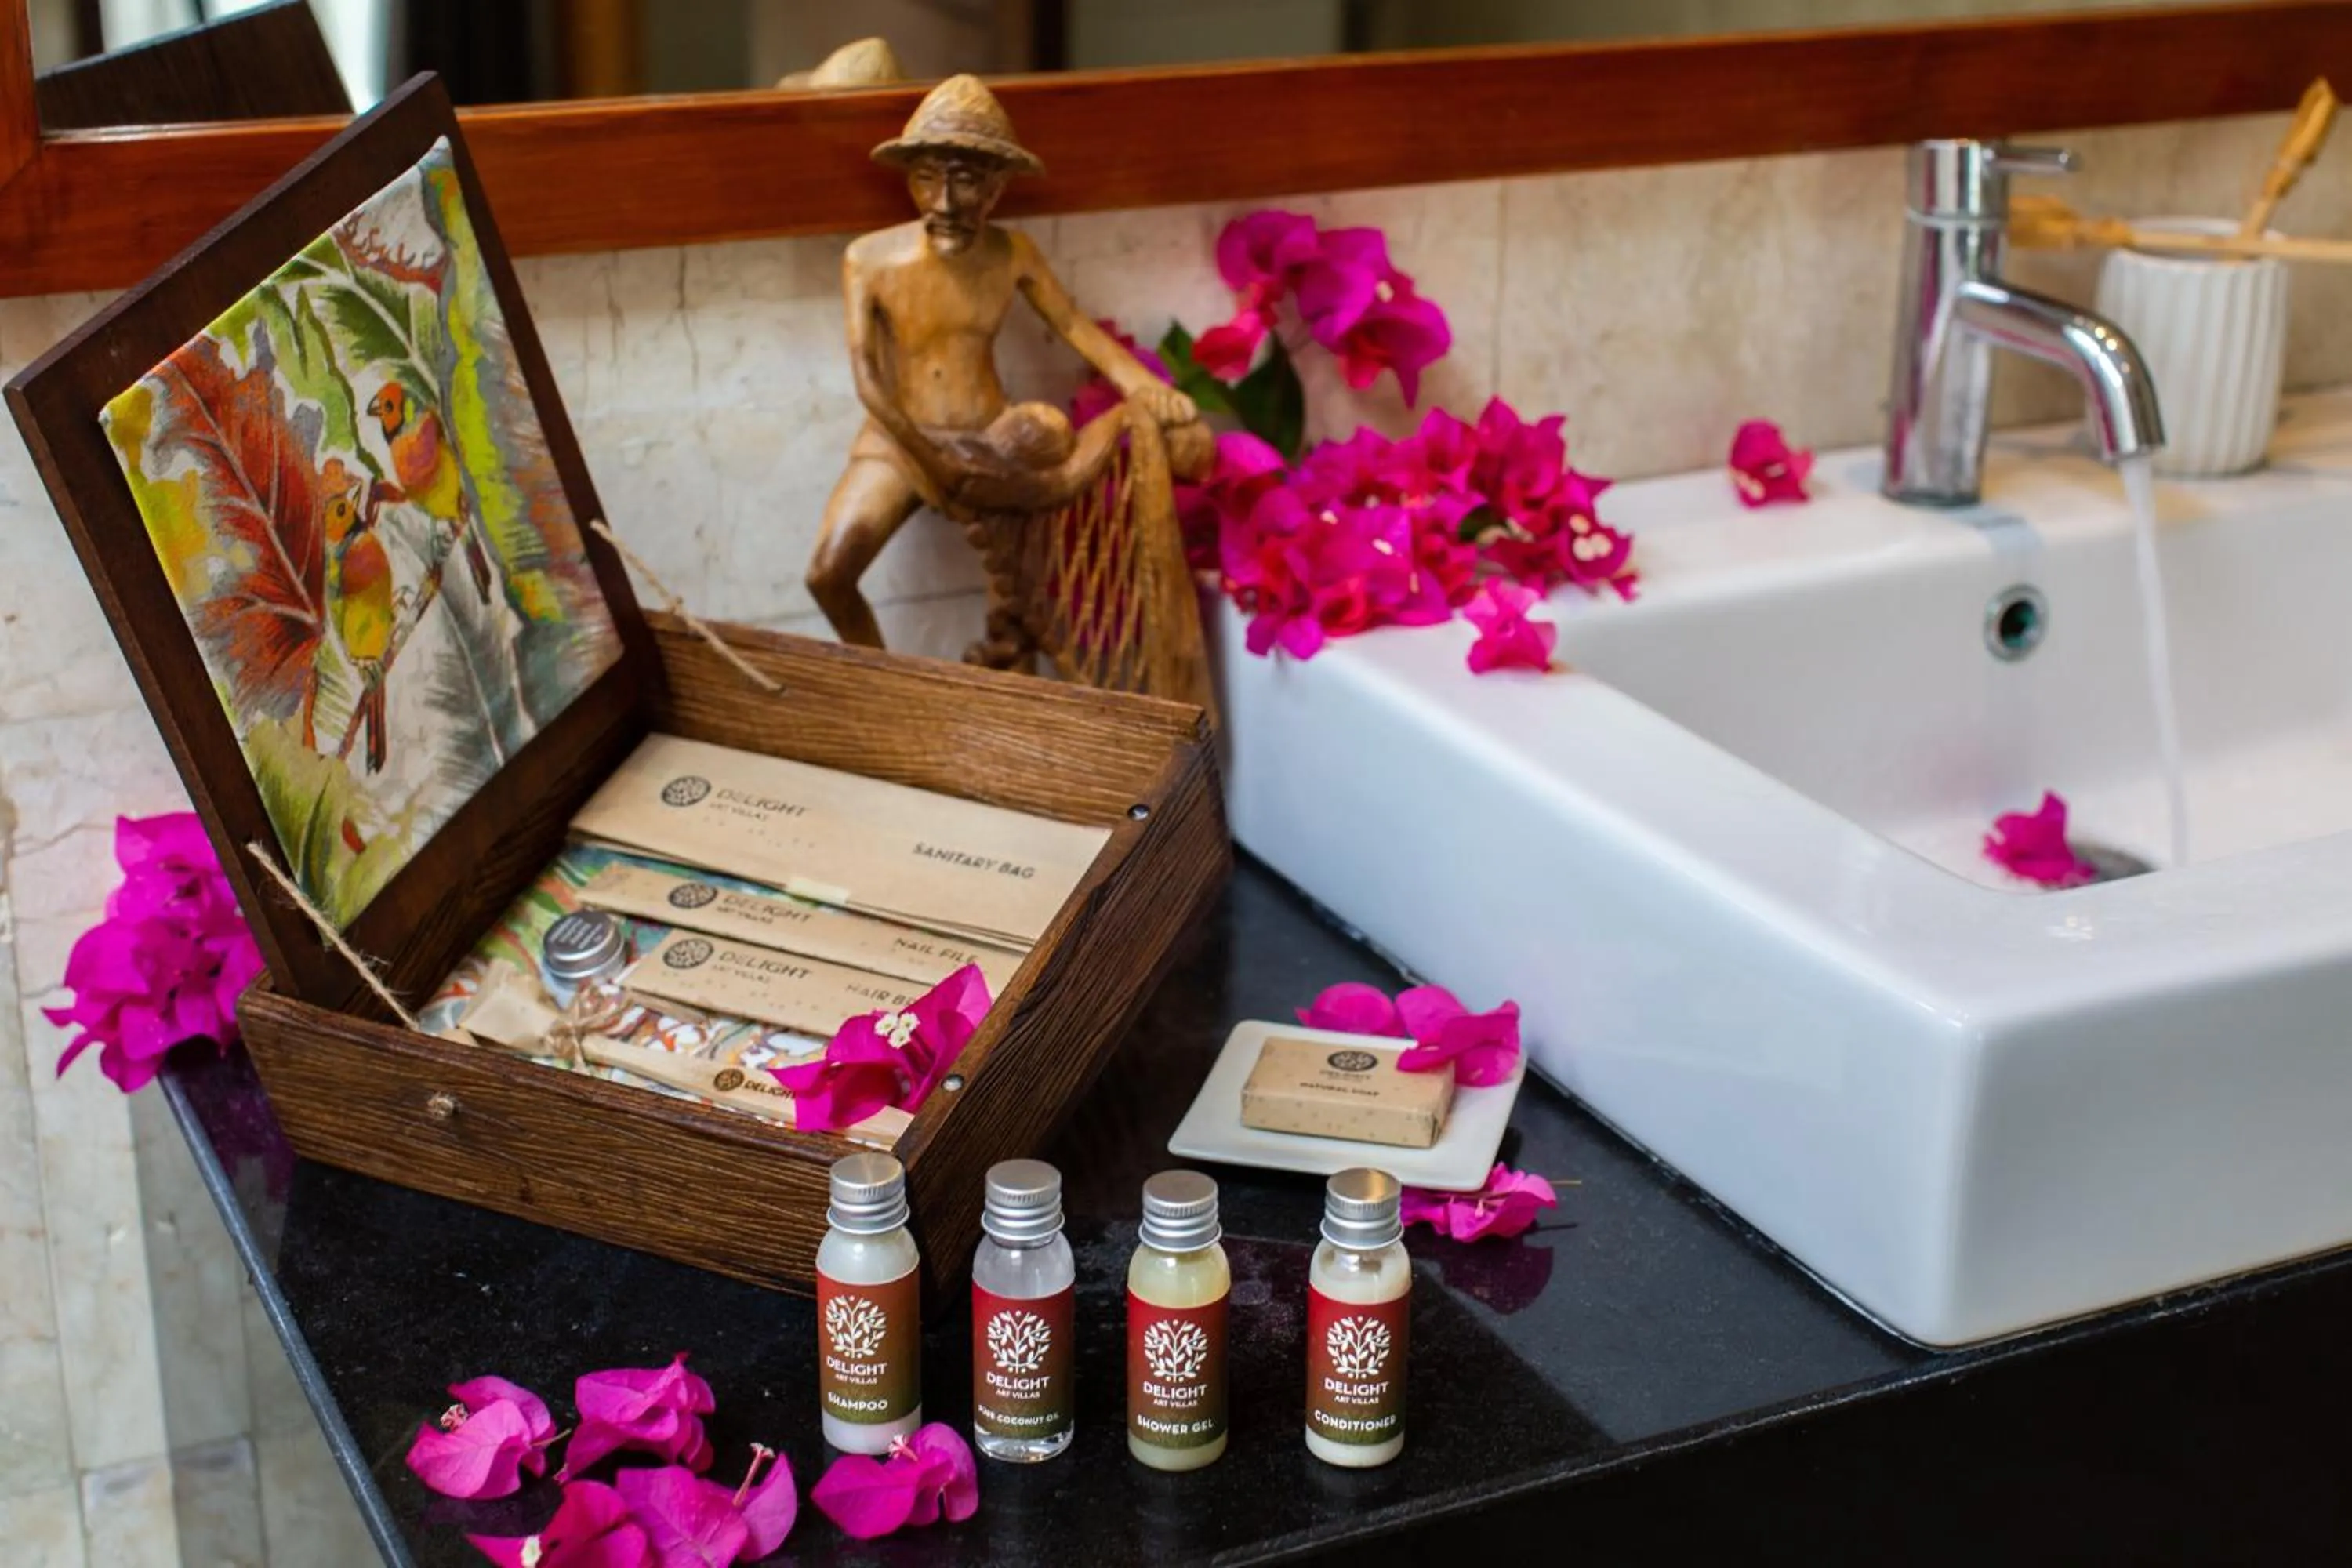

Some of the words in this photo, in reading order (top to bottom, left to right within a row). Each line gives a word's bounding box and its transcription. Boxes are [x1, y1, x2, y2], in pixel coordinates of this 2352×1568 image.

[717, 789, 811, 817] DELIGHT
[913, 841, 998, 870] SANITARY
[998, 862, 1036, 879] BAG
[895, 938, 934, 955] NAIL
[939, 947, 978, 964] FILE
[719, 950, 813, 980] DELIGHT
[846, 982, 890, 1001] HAIR
[826, 1355, 888, 1375] DELIGHT
[835, 1372, 848, 1382] ART
[849, 1376, 877, 1385] VILLAS
[986, 1371, 1051, 1390] DELIGHT
[1324, 1377, 1389, 1396] DELIGHT
[996, 1388, 1011, 1398] ART
[1012, 1391, 1040, 1399] VILLAS
[1143, 1381, 1207, 1399] DELIGHT
[828, 1392, 888, 1411] SHAMPOO
[1153, 1398, 1168, 1407] ART
[1170, 1400, 1198, 1409] VILLAS
[1334, 1395, 1350, 1403] ART
[1351, 1396, 1380, 1406] VILLAS
[996, 1414, 1044, 1425] COCONUT
[1138, 1414, 1189, 1435] SHOWER
[1191, 1417, 1214, 1433] GEL
[1314, 1409, 1397, 1432] CONDITIONER
